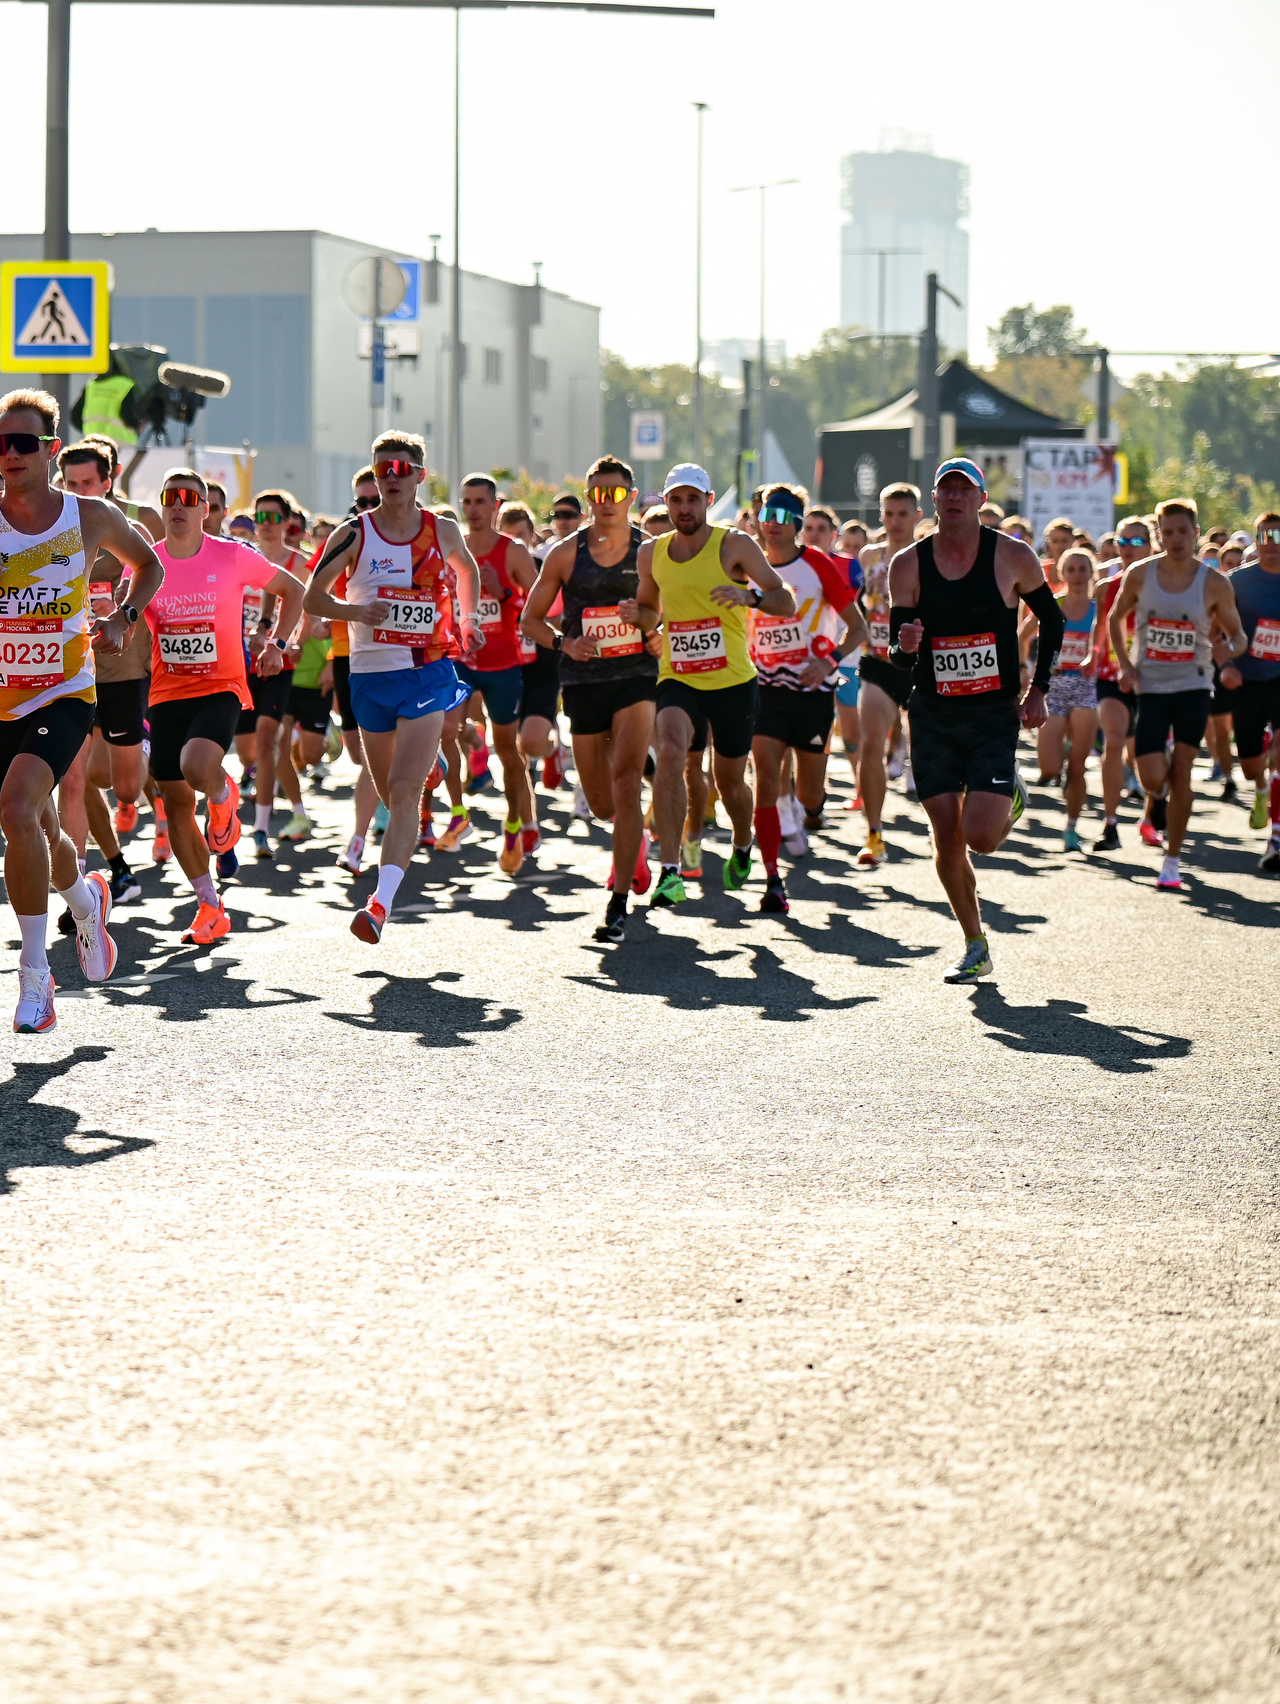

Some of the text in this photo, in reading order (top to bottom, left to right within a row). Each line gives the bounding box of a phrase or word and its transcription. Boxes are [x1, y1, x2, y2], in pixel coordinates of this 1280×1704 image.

[18, 601, 71, 615] HARD
[156, 592, 217, 608] RUNNING
[166, 603, 216, 617] Sarcasm
[385, 603, 433, 624] 1938
[394, 622, 418, 630] АНДРЕЙ
[671, 632, 721, 652] 25459
[758, 626, 801, 646] 29531
[1149, 629, 1194, 647] 37518
[160, 637, 214, 655] 34826
[935, 649, 995, 672] 30136
